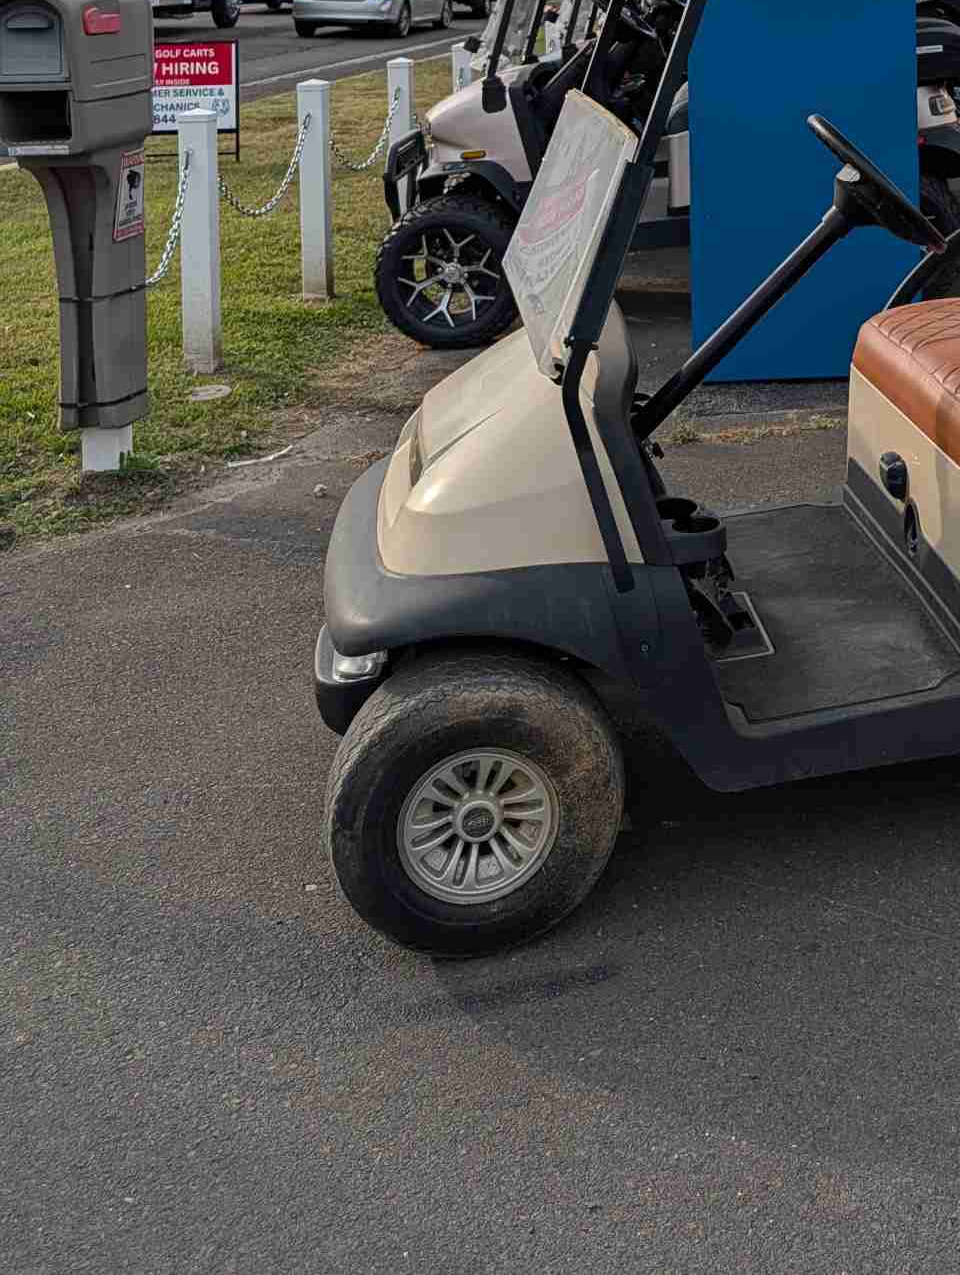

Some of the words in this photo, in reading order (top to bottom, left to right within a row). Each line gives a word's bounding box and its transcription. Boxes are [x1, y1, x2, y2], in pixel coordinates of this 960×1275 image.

[155, 48, 182, 59] GOLF
[183, 48, 216, 58] CARTS
[161, 61, 220, 76] HIRING
[173, 88, 216, 98] SERVICE
